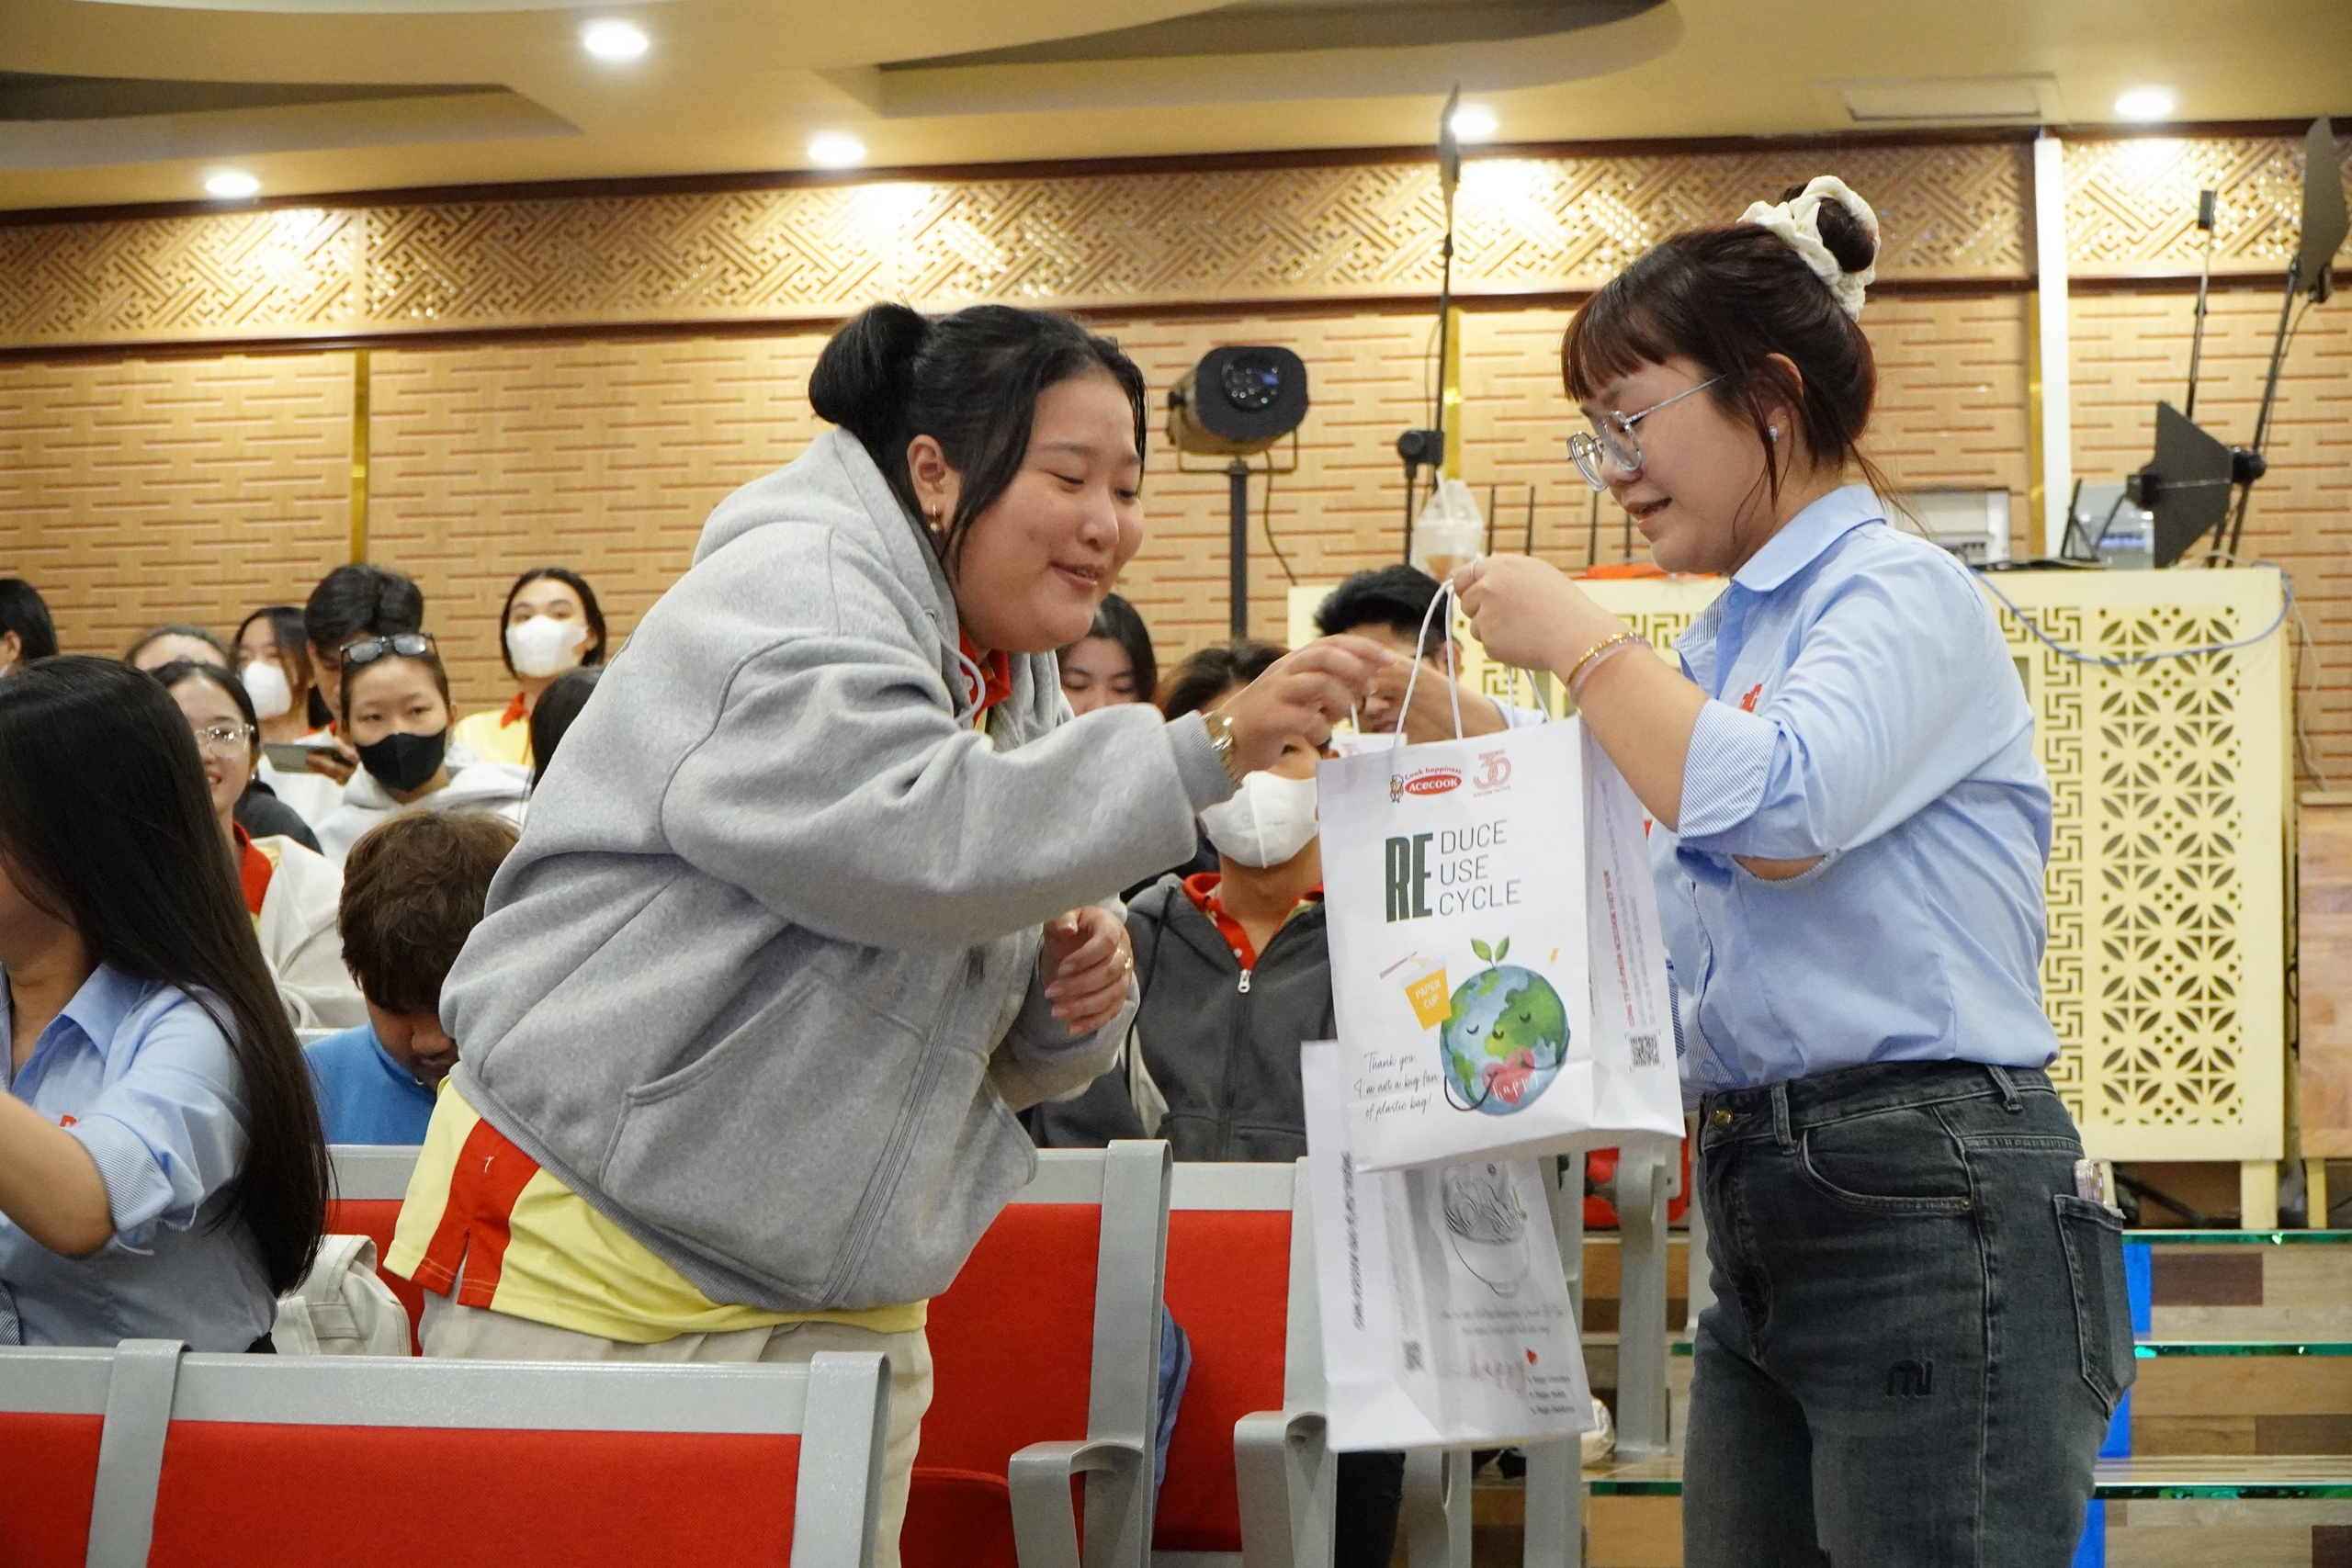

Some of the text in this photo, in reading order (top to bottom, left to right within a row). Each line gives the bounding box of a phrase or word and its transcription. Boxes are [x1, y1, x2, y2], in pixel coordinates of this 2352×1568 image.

[1405, 765, 1462, 780] Cook happiness
[1385, 819, 1508, 923] RE DUCE
[1441, 854, 1489, 886] USE
[1439, 879, 1521, 916] CYCLE
[1416, 979, 1442, 999] PAPER
[1424, 993, 1439, 1009] CUP
[1364, 1052, 1397, 1073] Thank
[1378, 1079, 1393, 1092] not
[1395, 1080, 1401, 1089] a
[1423, 1069, 1439, 1087] fan
[1365, 1102, 1375, 1120] of
[1375, 1100, 1408, 1122] plastic
